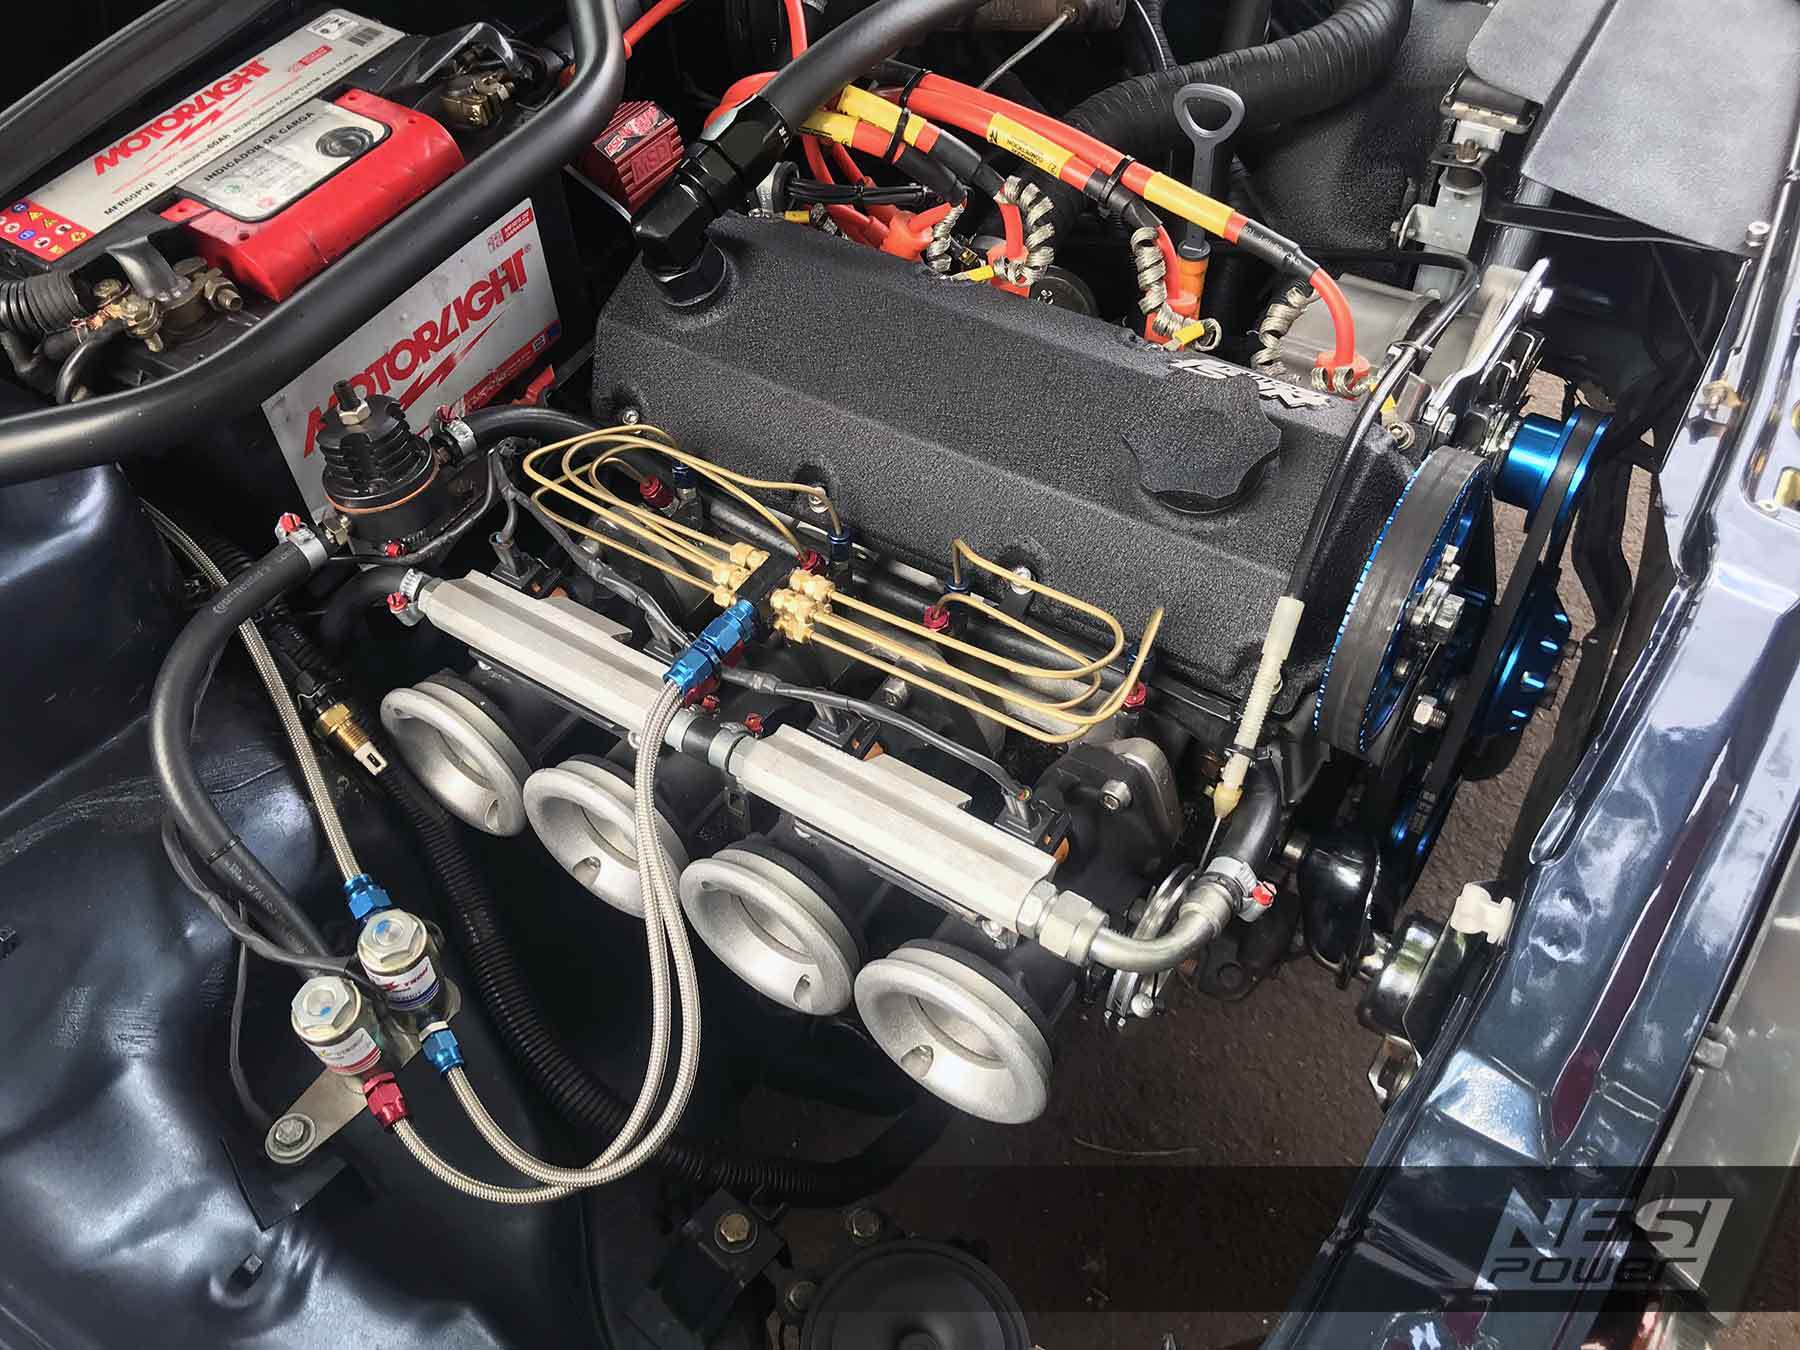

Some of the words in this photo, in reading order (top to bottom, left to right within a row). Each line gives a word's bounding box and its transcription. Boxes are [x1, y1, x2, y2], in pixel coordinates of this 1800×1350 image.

[93, 59, 271, 176] MOTORLIGHT
[203, 143, 265, 182] INDICADOR
[263, 131, 280, 146] DE
[278, 110, 316, 136] CARGA
